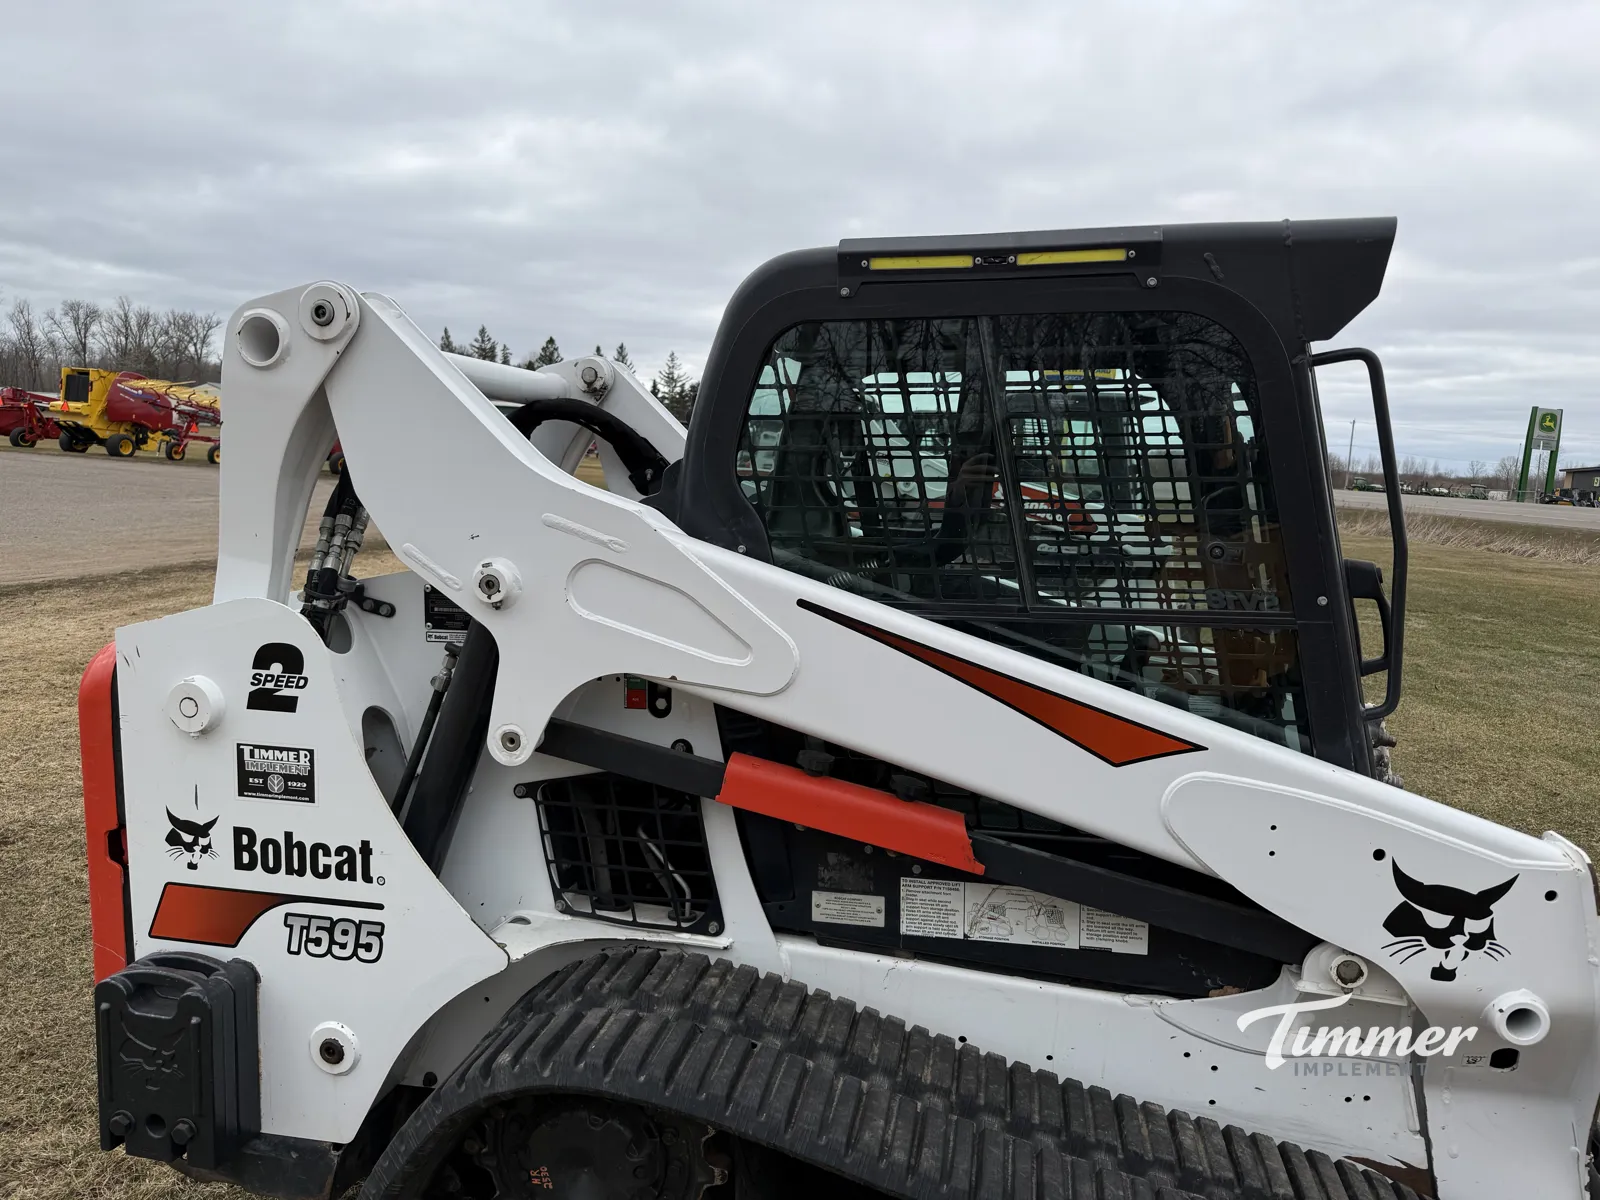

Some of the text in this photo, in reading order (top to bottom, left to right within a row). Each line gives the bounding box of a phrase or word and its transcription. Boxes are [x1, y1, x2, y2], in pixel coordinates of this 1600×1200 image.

[246, 642, 304, 713] 2
[250, 672, 309, 690] SPEED
[239, 745, 311, 765] TIMMER
[245, 760, 311, 776] IMPLEMENT
[244, 791, 310, 801] www.timmerimplement.com
[233, 826, 374, 884] Bobcat
[284, 912, 385, 964] T595
